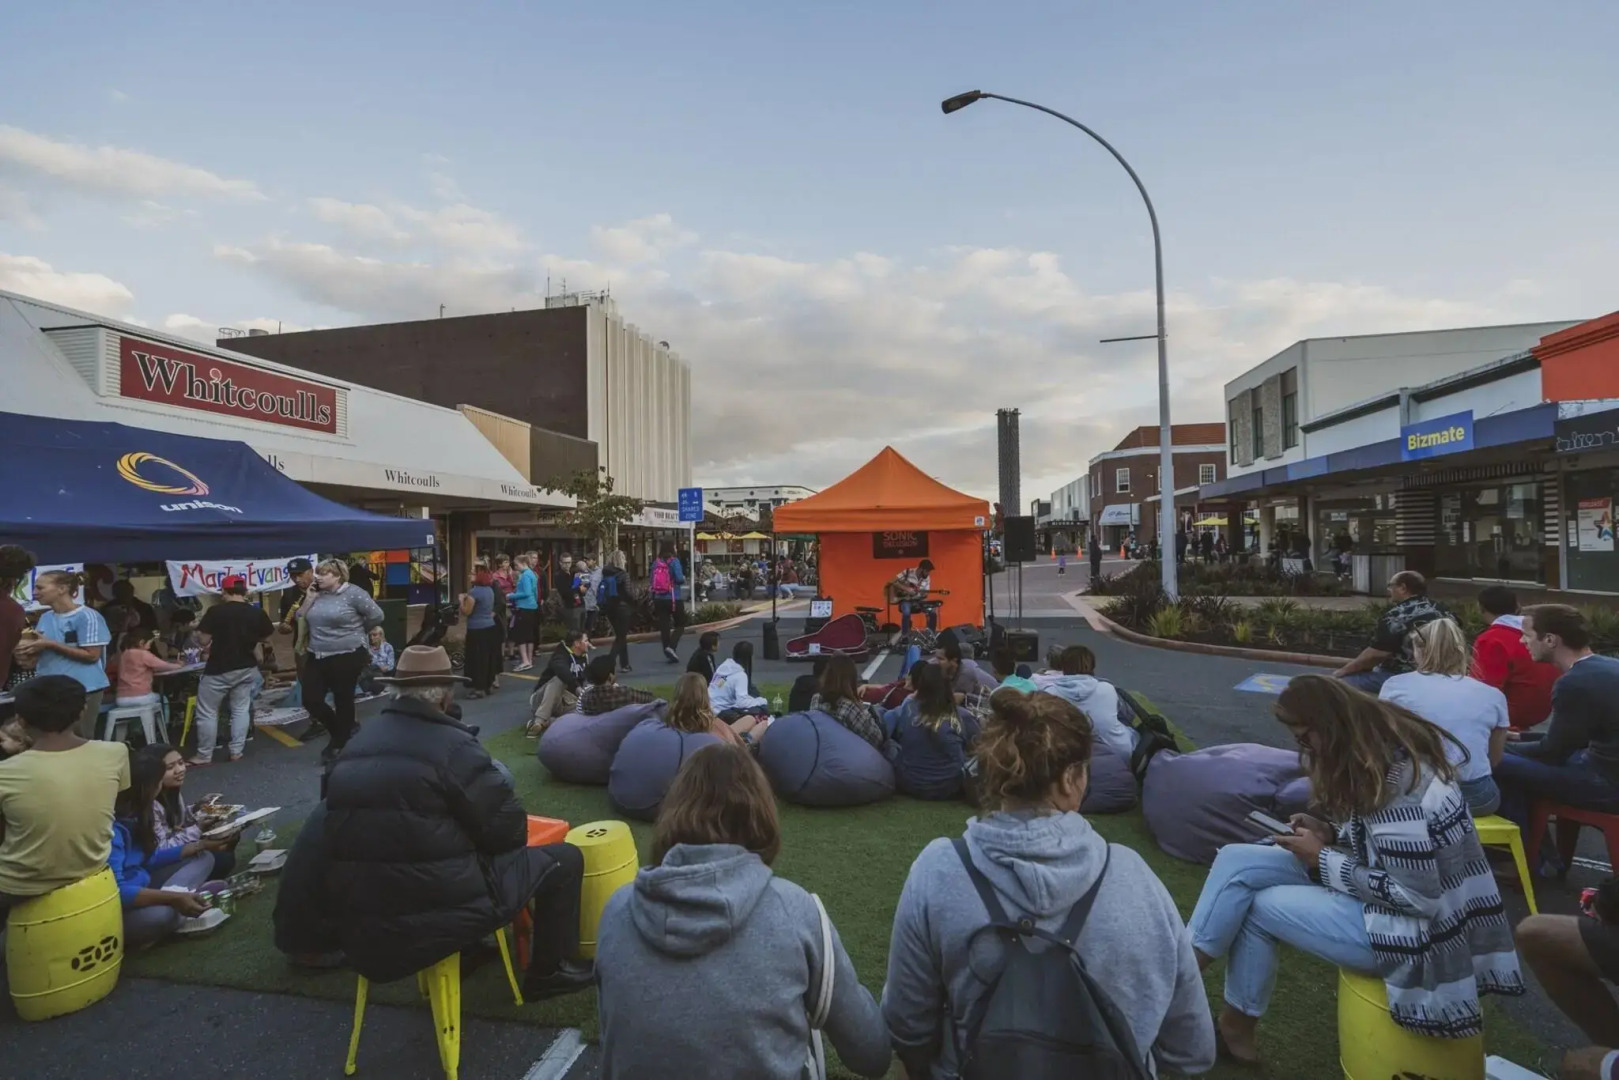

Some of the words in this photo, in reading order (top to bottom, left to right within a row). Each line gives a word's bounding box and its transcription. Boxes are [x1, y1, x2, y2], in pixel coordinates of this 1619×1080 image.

[132, 351, 330, 424] Whitcoulls
[1407, 426, 1465, 451] Bizmate
[385, 469, 440, 488] Whitcoulls
[500, 484, 537, 499] Whitcoulls
[160, 499, 243, 514] unison
[882, 530, 918, 541] SONIC
